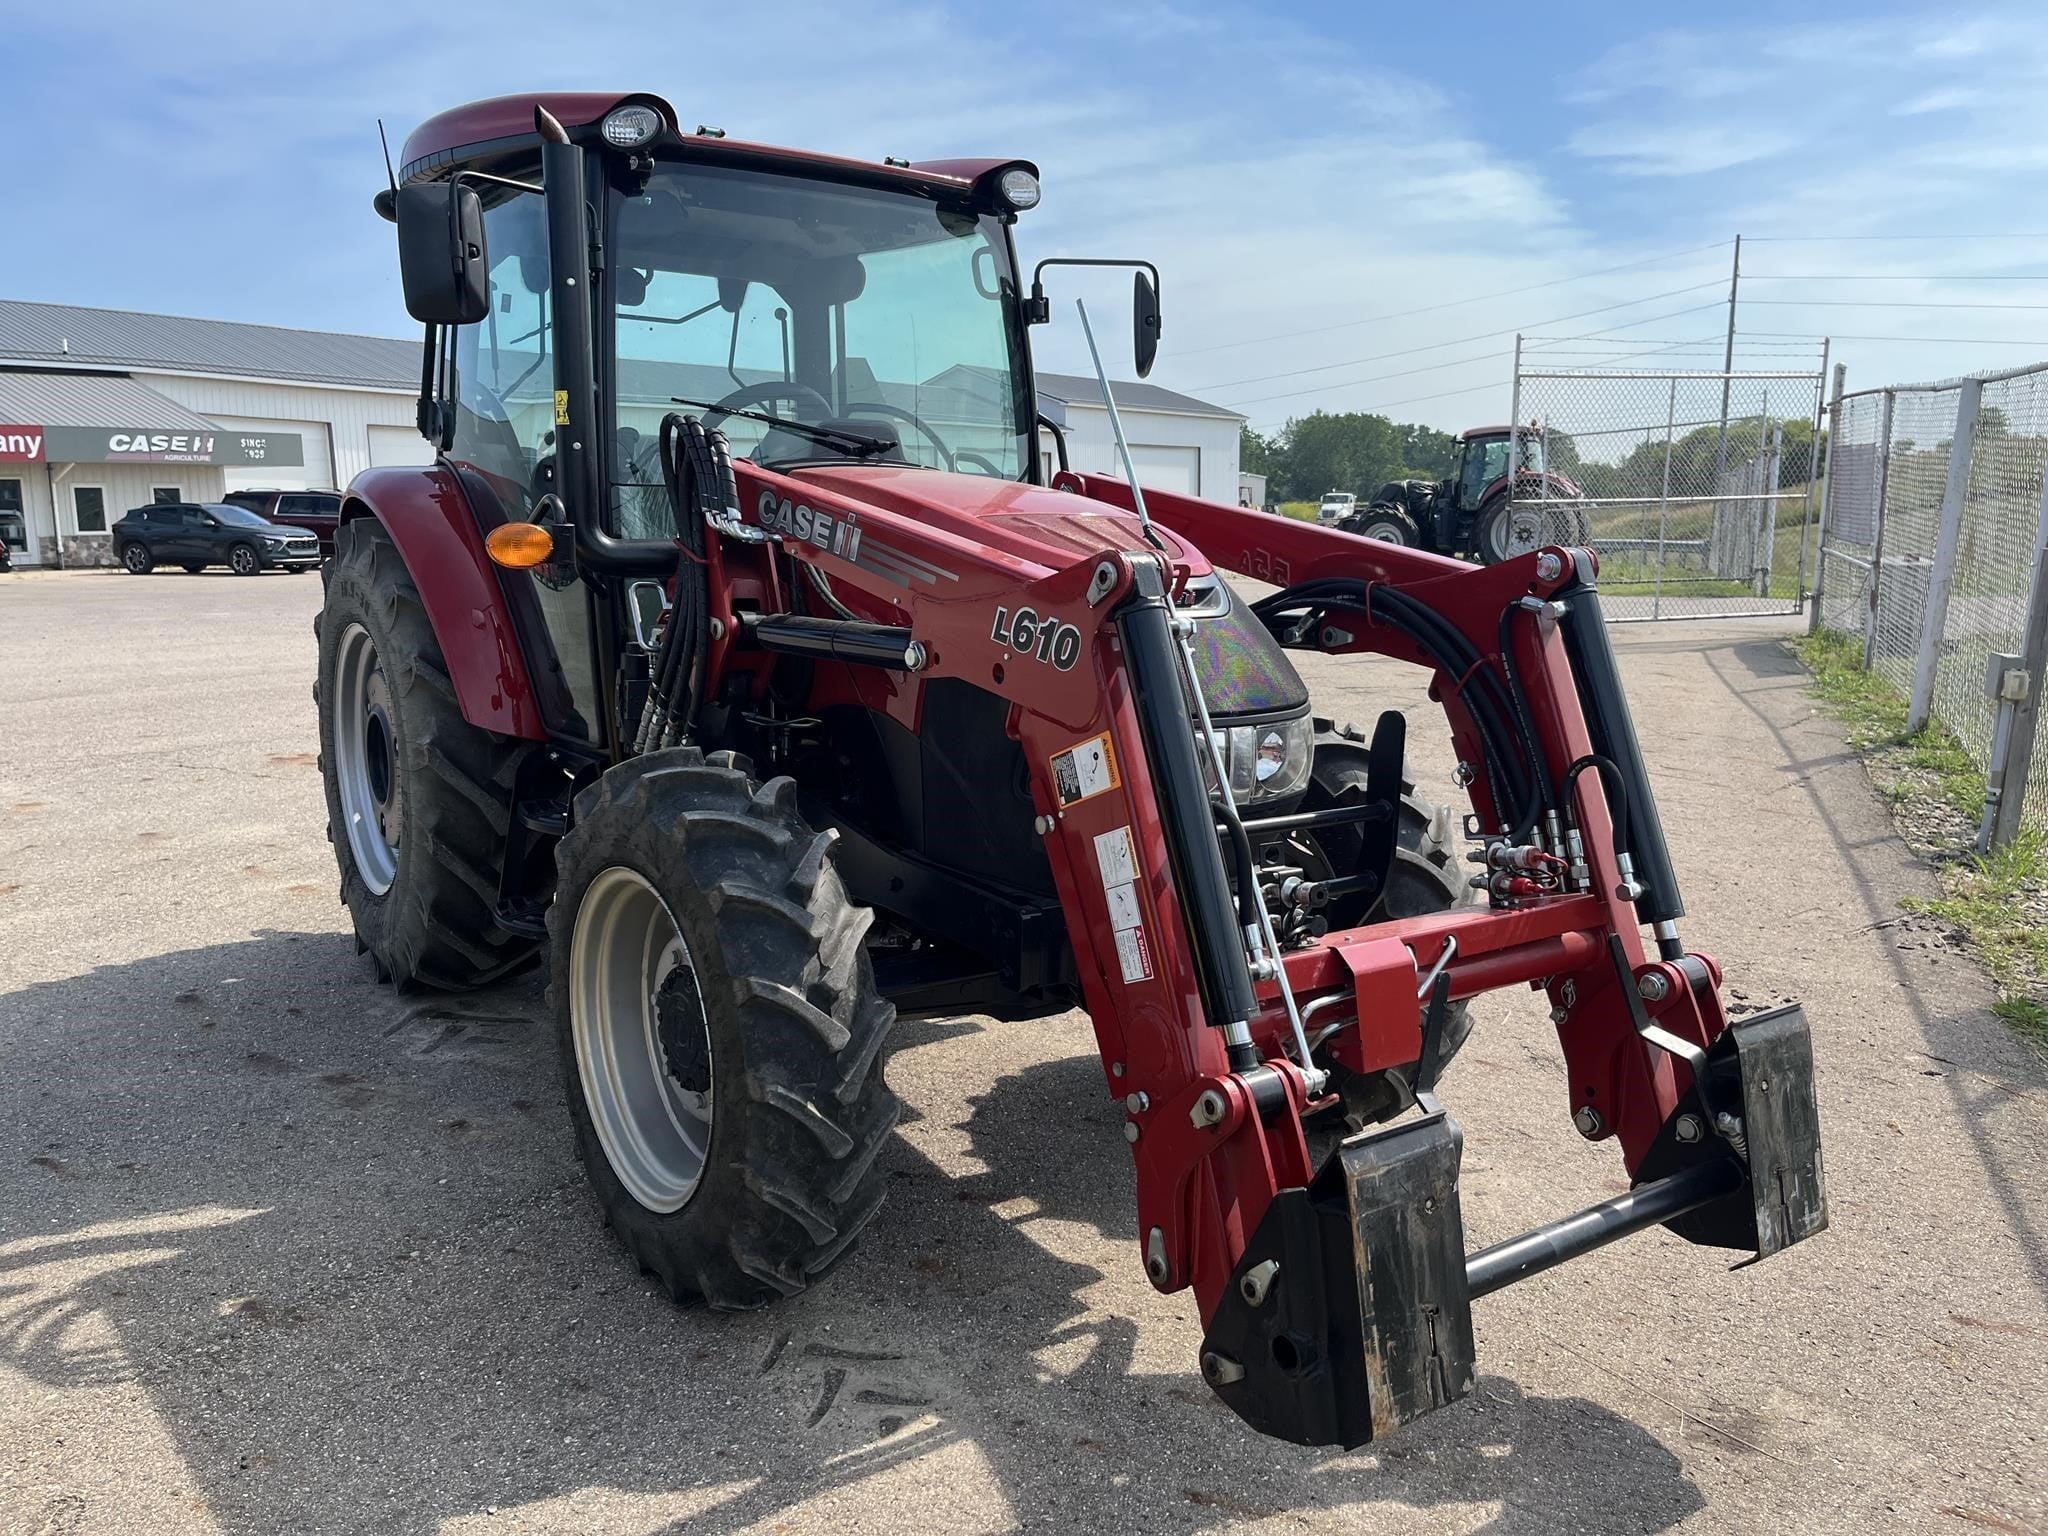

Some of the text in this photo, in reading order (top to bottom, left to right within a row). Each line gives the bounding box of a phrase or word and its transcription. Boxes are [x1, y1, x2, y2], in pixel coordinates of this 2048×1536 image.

[109, 434, 189, 452] CASE
[164, 454, 212, 462] AGRICULTURE
[758, 490, 833, 549] CASE
[991, 606, 1081, 672] L610
[1104, 747, 1117, 783] WARNING
[1137, 938, 1150, 975] DANGER
